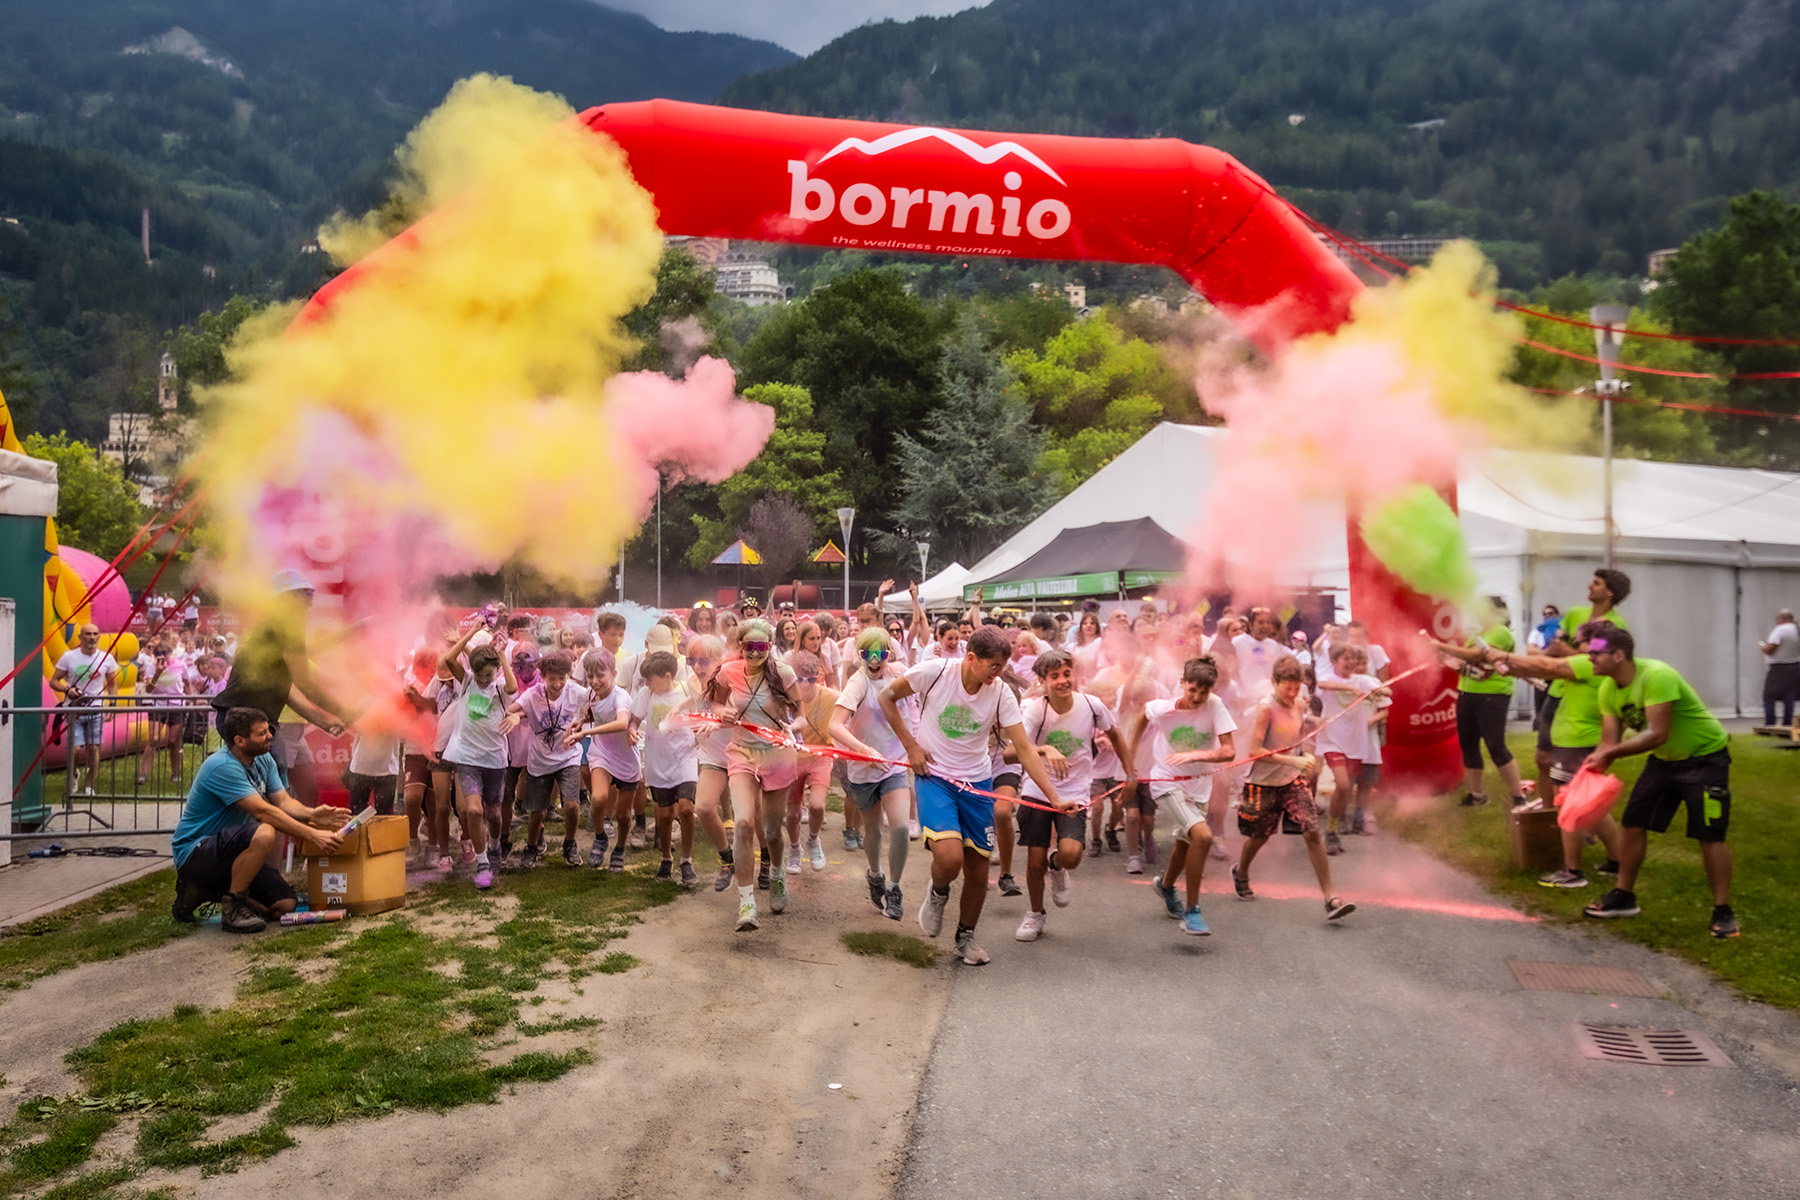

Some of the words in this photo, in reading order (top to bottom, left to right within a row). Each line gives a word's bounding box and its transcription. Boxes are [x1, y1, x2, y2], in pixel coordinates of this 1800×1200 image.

[787, 159, 1071, 240] bormio
[832, 235, 859, 246] the
[863, 238, 932, 251] wellness
[935, 244, 1012, 256] mountain
[1409, 703, 1457, 727] sond
